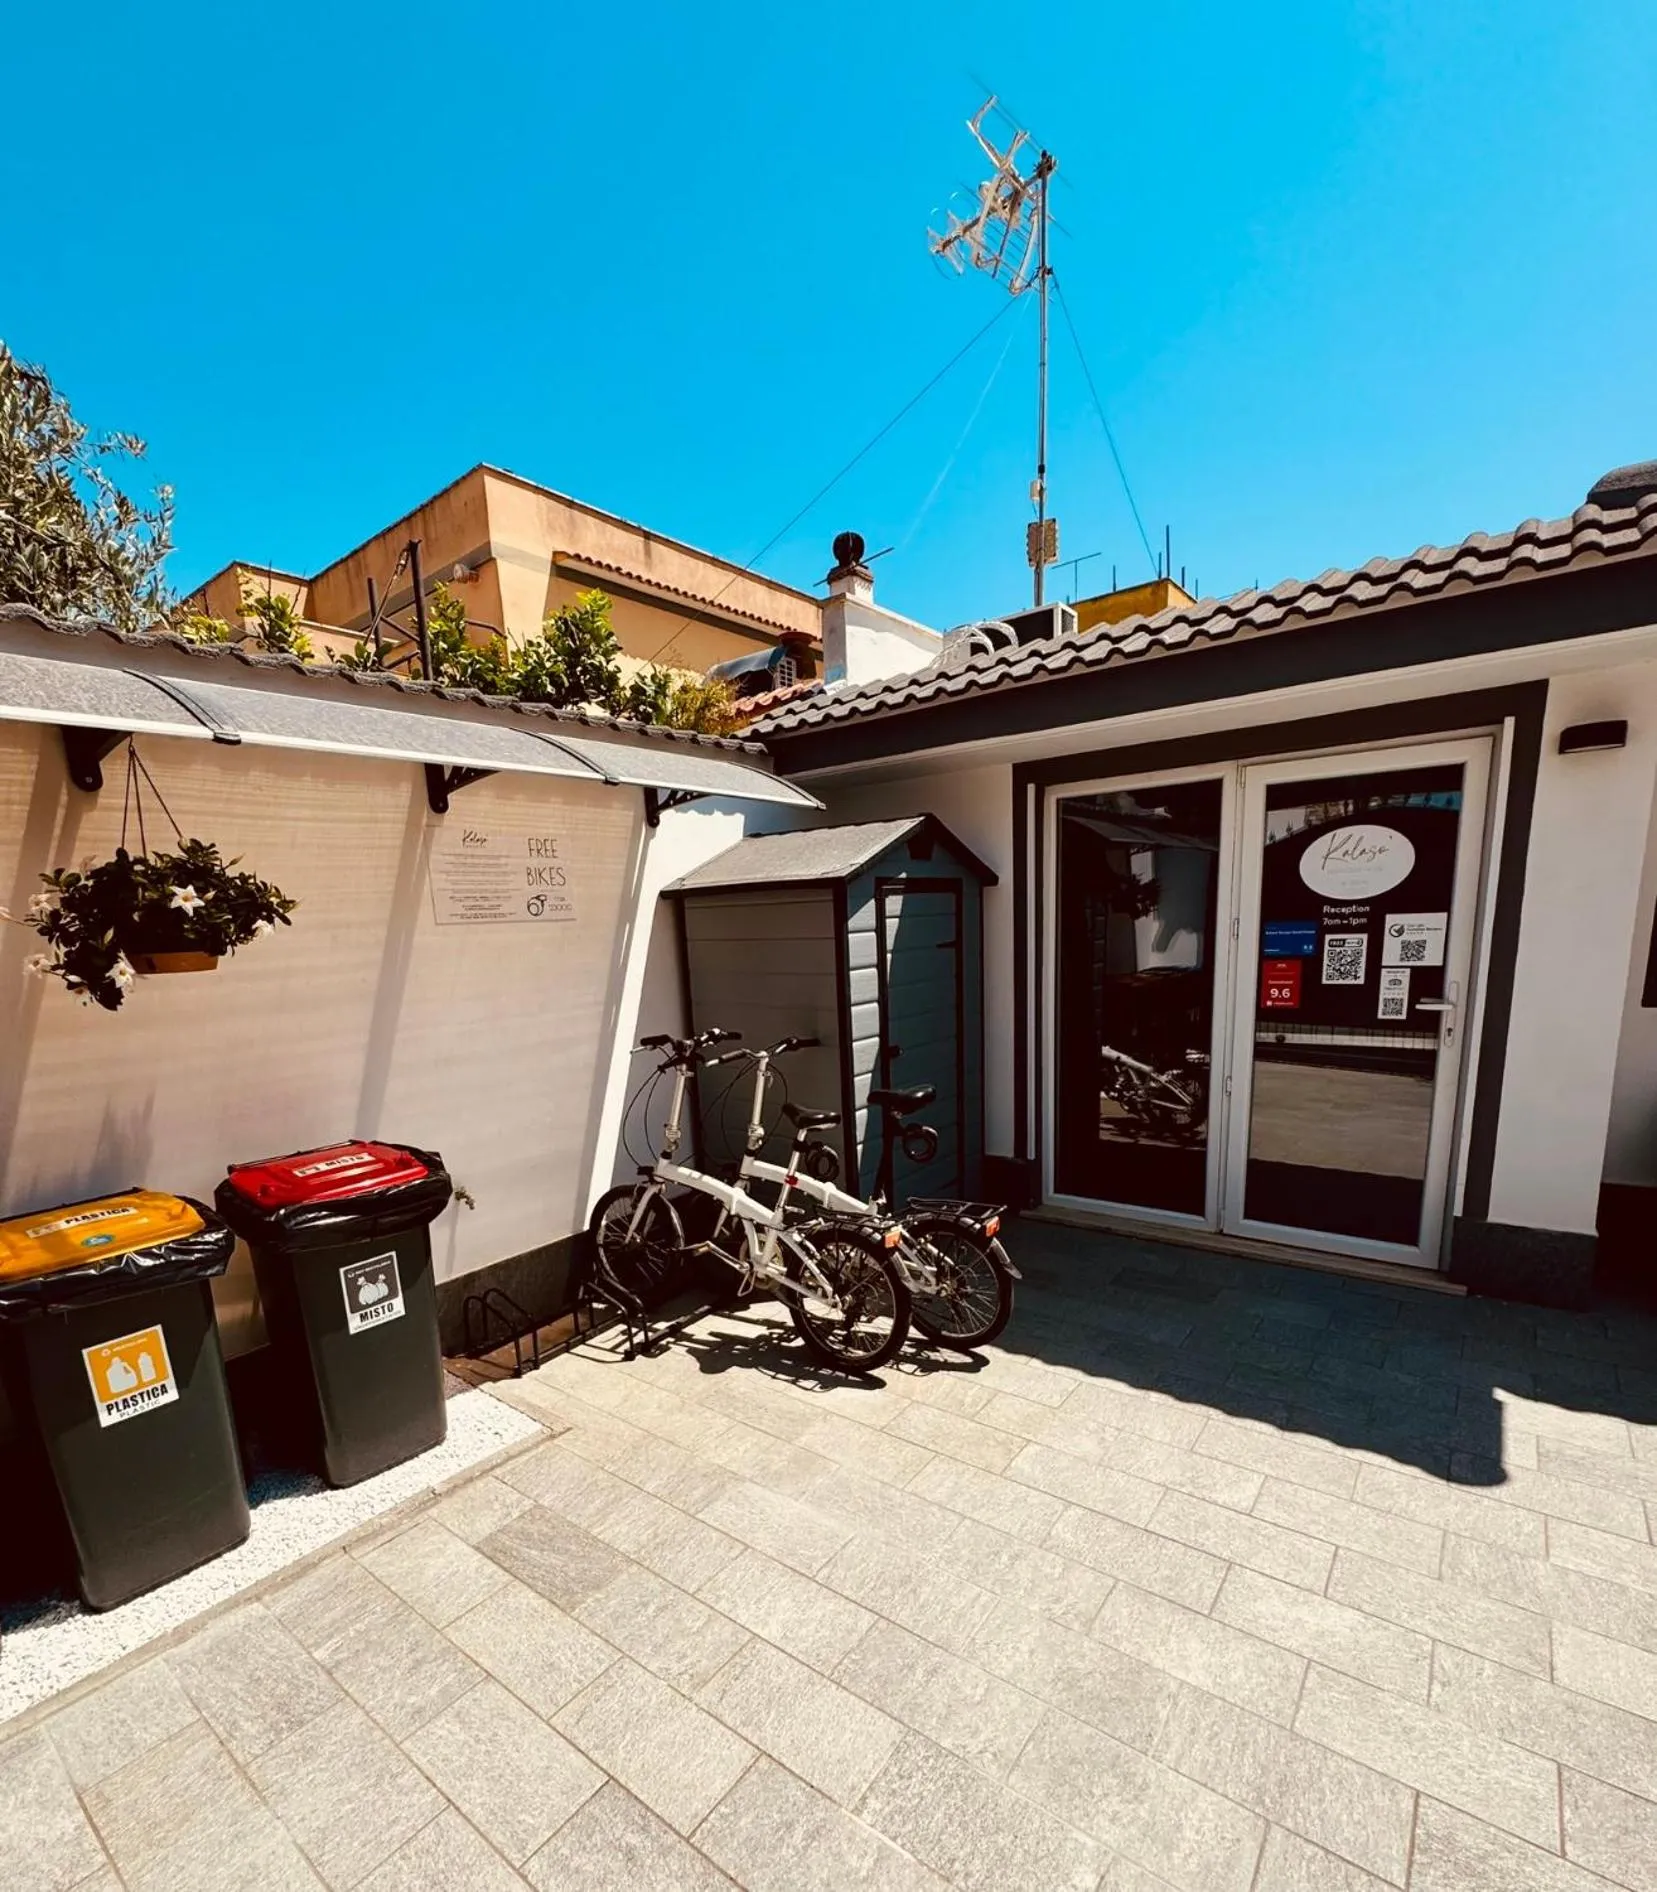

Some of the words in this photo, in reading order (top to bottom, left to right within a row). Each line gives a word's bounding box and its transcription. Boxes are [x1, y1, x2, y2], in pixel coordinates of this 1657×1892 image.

[528, 838, 559, 858] FREE
[526, 866, 566, 886] BIKES
[1323, 904, 1370, 915] Reception
[1270, 988, 1291, 998] 9.6
[64, 1207, 130, 1225] PLASTICA
[360, 1302, 394, 1323] MISTO
[106, 1383, 169, 1416] PLASTICA
[120, 1400, 160, 1418] PLASTIC
